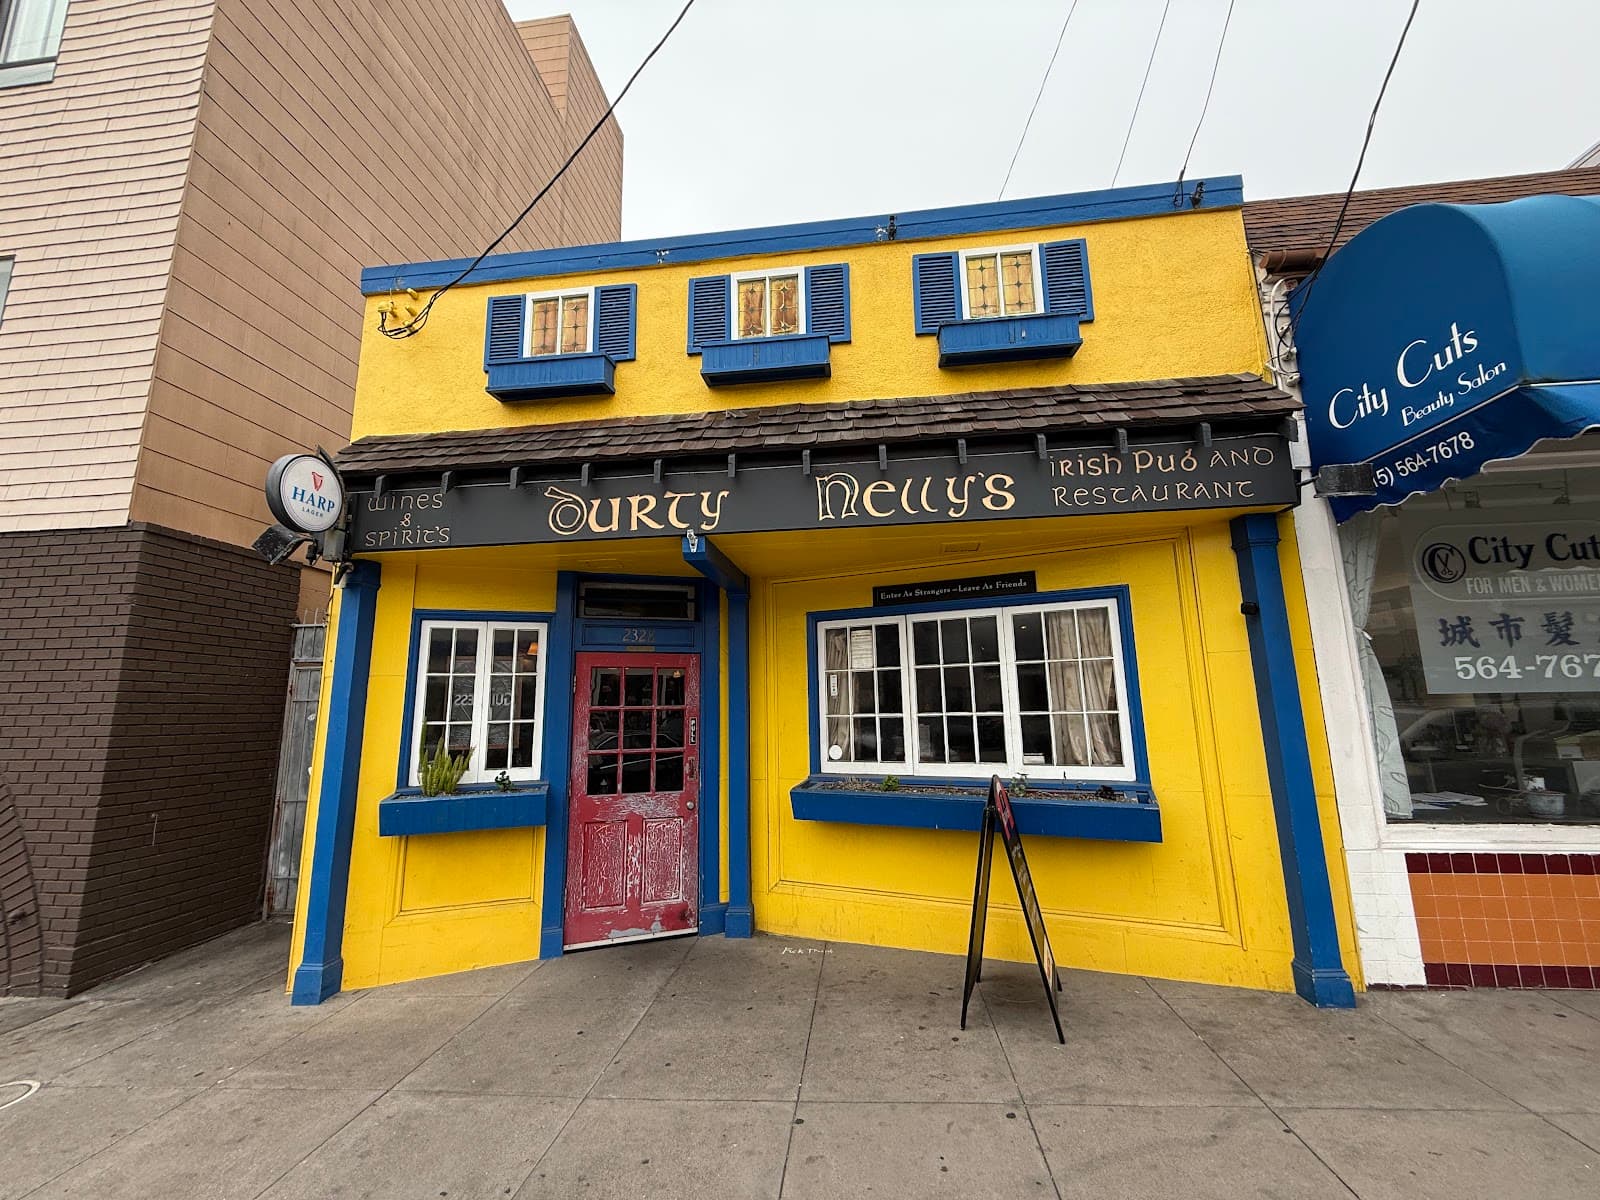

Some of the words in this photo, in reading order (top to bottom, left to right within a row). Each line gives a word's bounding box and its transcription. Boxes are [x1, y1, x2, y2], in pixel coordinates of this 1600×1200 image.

[1328, 382, 1389, 430] City
[1396, 322, 1479, 388] Cuts
[1402, 390, 1454, 427] Beauty
[1457, 361, 1507, 396] Salon
[1209, 446, 1274, 468] AND
[1397, 431, 1476, 478] 564-7678
[291, 485, 336, 513] HARP
[301, 506, 324, 518] LAGER
[400, 512, 411, 527] &
[1468, 535, 1535, 570] City
[880, 591, 901, 600] Enter
[902, 589, 913, 598] As
[914, 587, 951, 598] Strangers
[958, 584, 981, 593] Leave
[982, 582, 993, 590] As
[995, 578, 1028, 590] Friends
[1465, 577, 1493, 595] FOR
[1500, 576, 1532, 594] MEN
[1536, 578, 1547, 593] &
[1549, 574, 1600, 592] WOME
[1438, 611, 1600, 649] 城市髮
